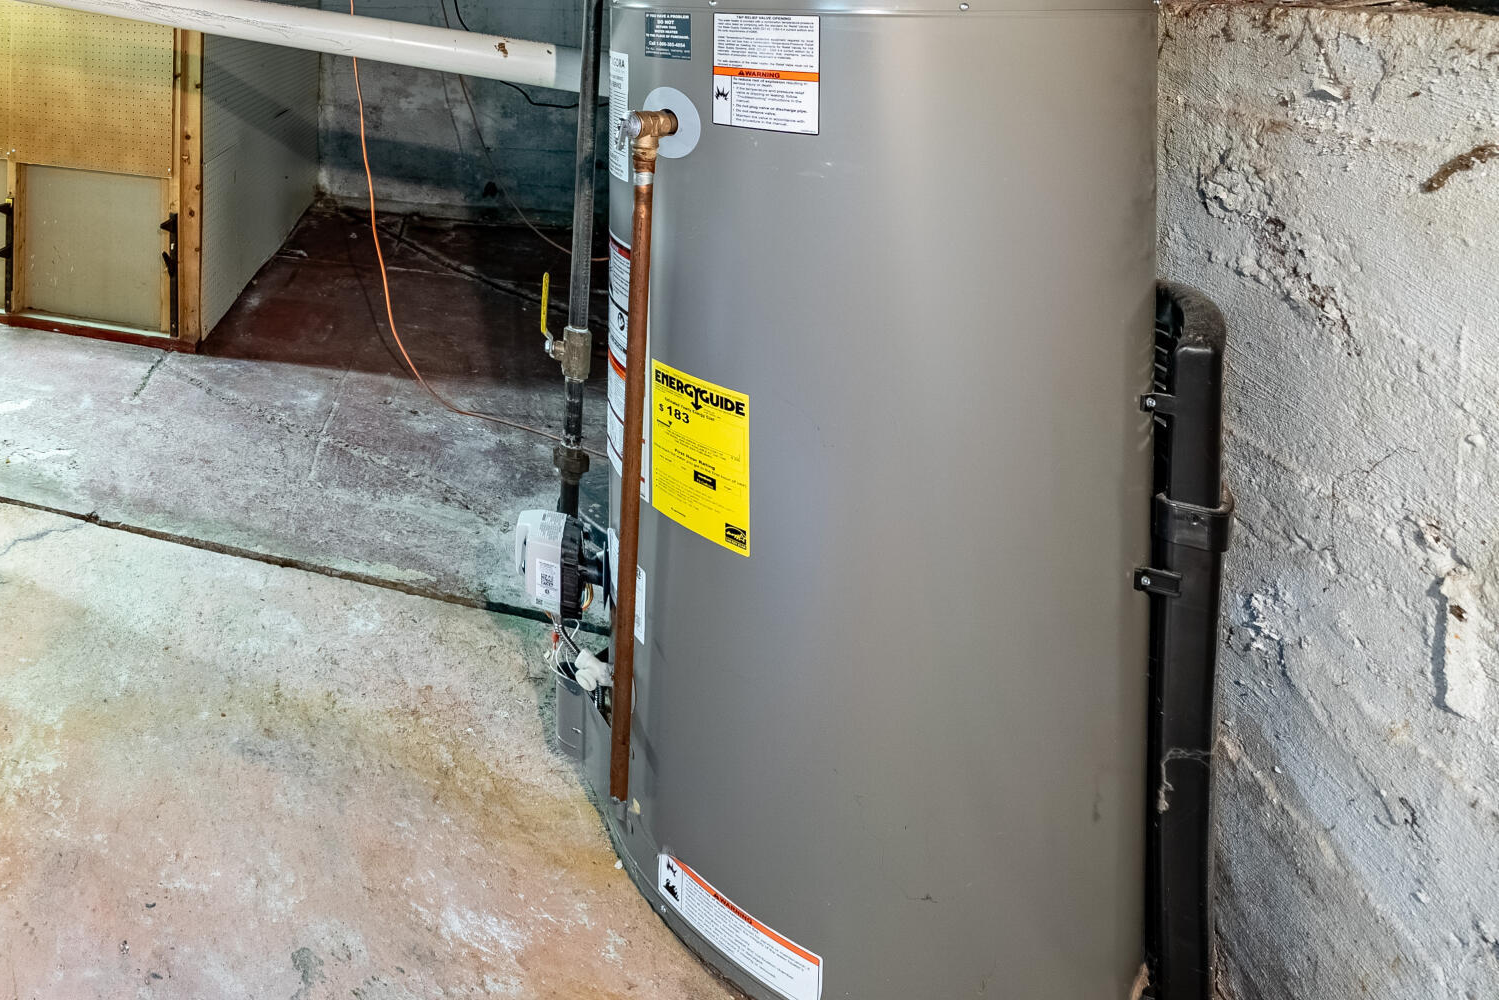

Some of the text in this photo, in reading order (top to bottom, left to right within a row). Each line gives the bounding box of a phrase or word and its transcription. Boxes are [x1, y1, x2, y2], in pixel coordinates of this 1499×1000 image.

[654, 368, 746, 417] ENERGYGUIDE
[658, 403, 664, 412] $
[666, 405, 690, 424] 183
[674, 448, 685, 457] First
[698, 459, 716, 471] Rating
[718, 897, 753, 925] WARNING
